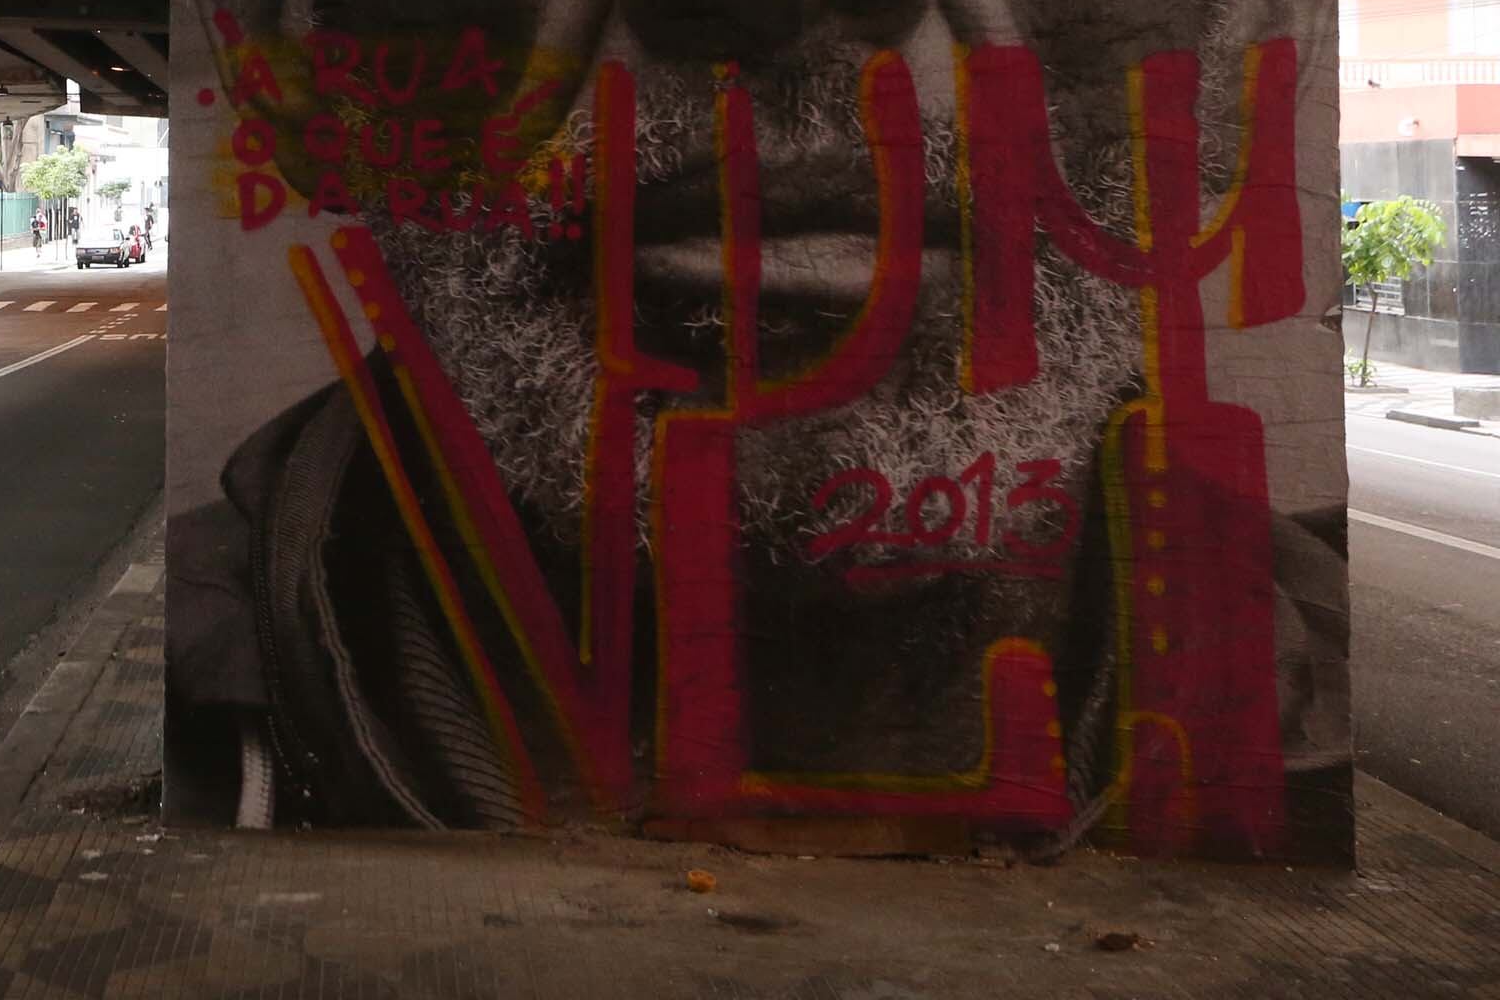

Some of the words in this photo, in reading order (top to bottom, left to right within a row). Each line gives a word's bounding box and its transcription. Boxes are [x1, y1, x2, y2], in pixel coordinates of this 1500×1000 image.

[304, 25, 505, 107] RUA
[233, 118, 277, 166] O
[304, 112, 453, 172] QUE
[806, 451, 1080, 558] 2013
